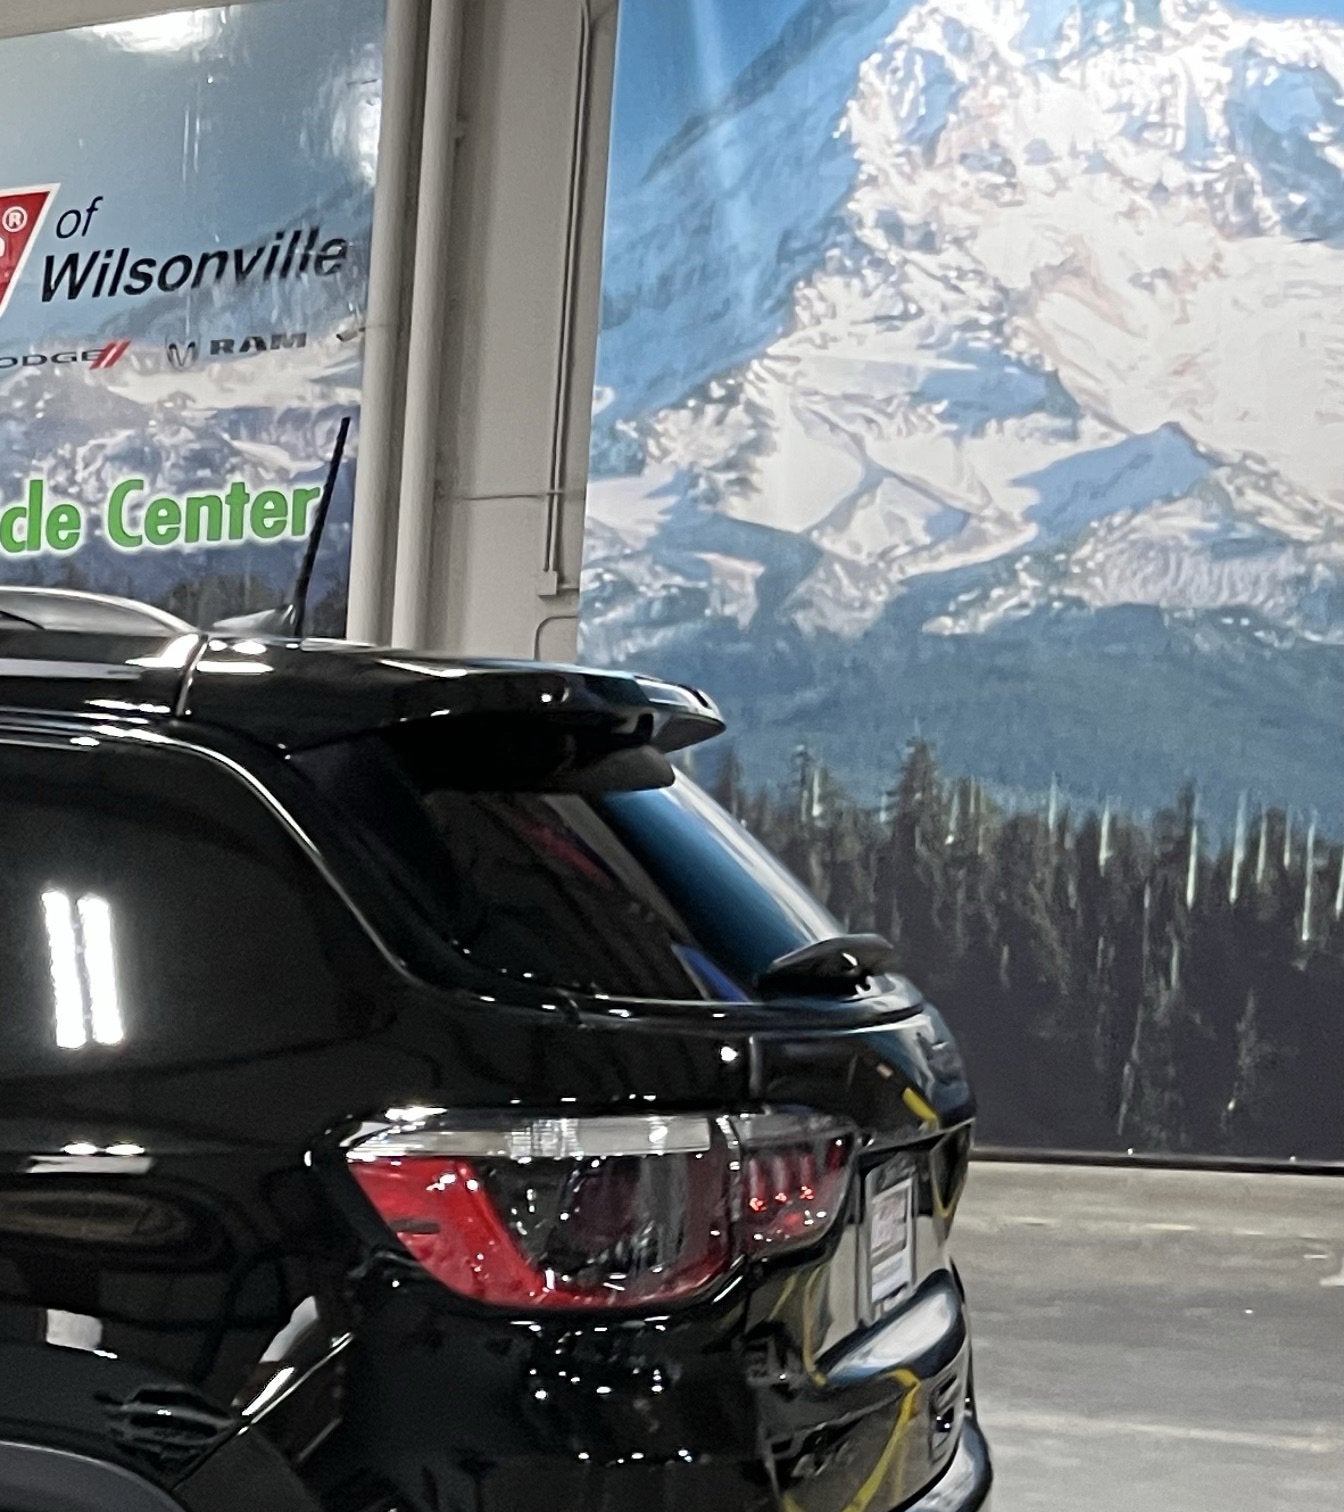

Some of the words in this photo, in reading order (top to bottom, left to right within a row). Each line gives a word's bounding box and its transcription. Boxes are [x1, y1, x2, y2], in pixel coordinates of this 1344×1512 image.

[55, 196, 104, 239] of
[41, 227, 349, 302] Wilsonville
[209, 332, 308, 355] RAM
[107, 479, 322, 547] Center
